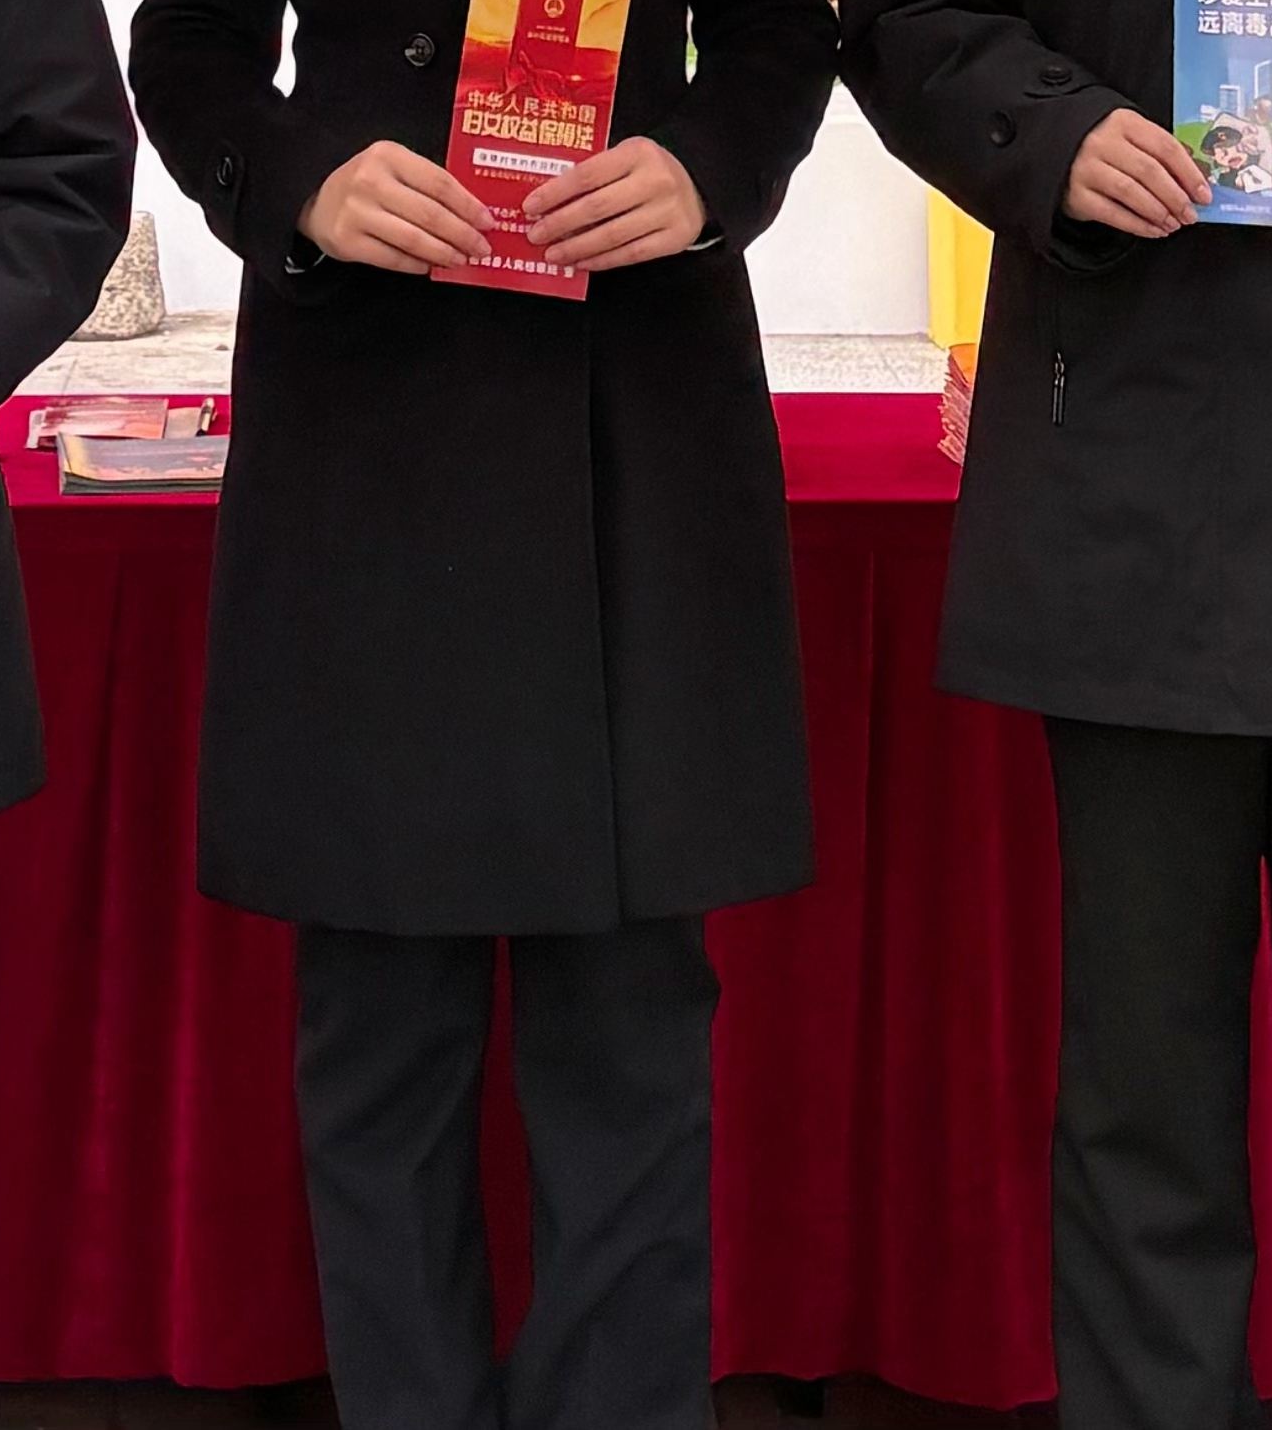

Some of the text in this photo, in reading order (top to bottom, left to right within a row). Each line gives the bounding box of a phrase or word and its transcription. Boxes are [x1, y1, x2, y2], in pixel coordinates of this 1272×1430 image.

[468, 89, 597, 124] 中华人民共和国
[461, 109, 595, 152] 妇女权益保障法
